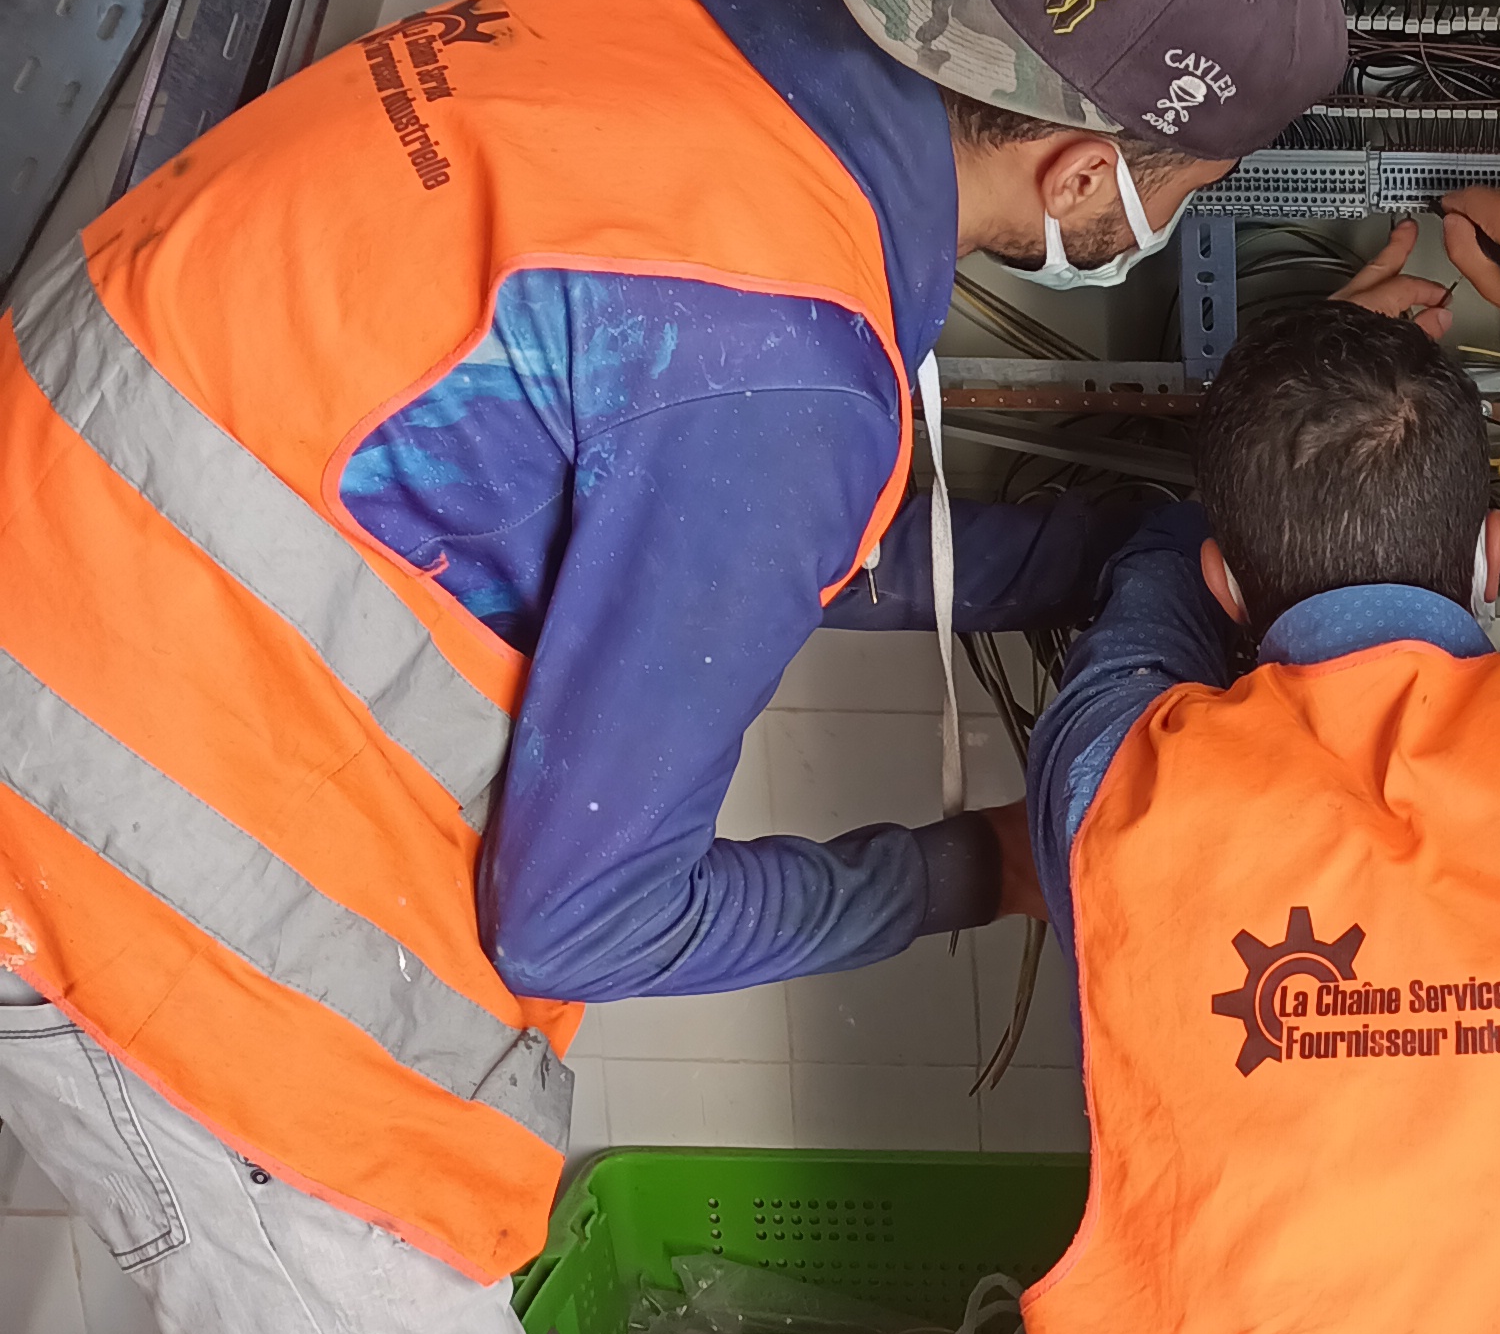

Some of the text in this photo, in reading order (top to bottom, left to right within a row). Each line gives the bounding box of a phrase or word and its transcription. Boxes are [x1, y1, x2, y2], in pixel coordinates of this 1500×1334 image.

[1164, 49, 1237, 105] CAYLER
[1141, 112, 1179, 135] SONS
[1278, 984, 1308, 1018] La
[1315, 980, 1401, 1017] Chaîne
[1285, 1023, 1448, 1060] Fournisseur
